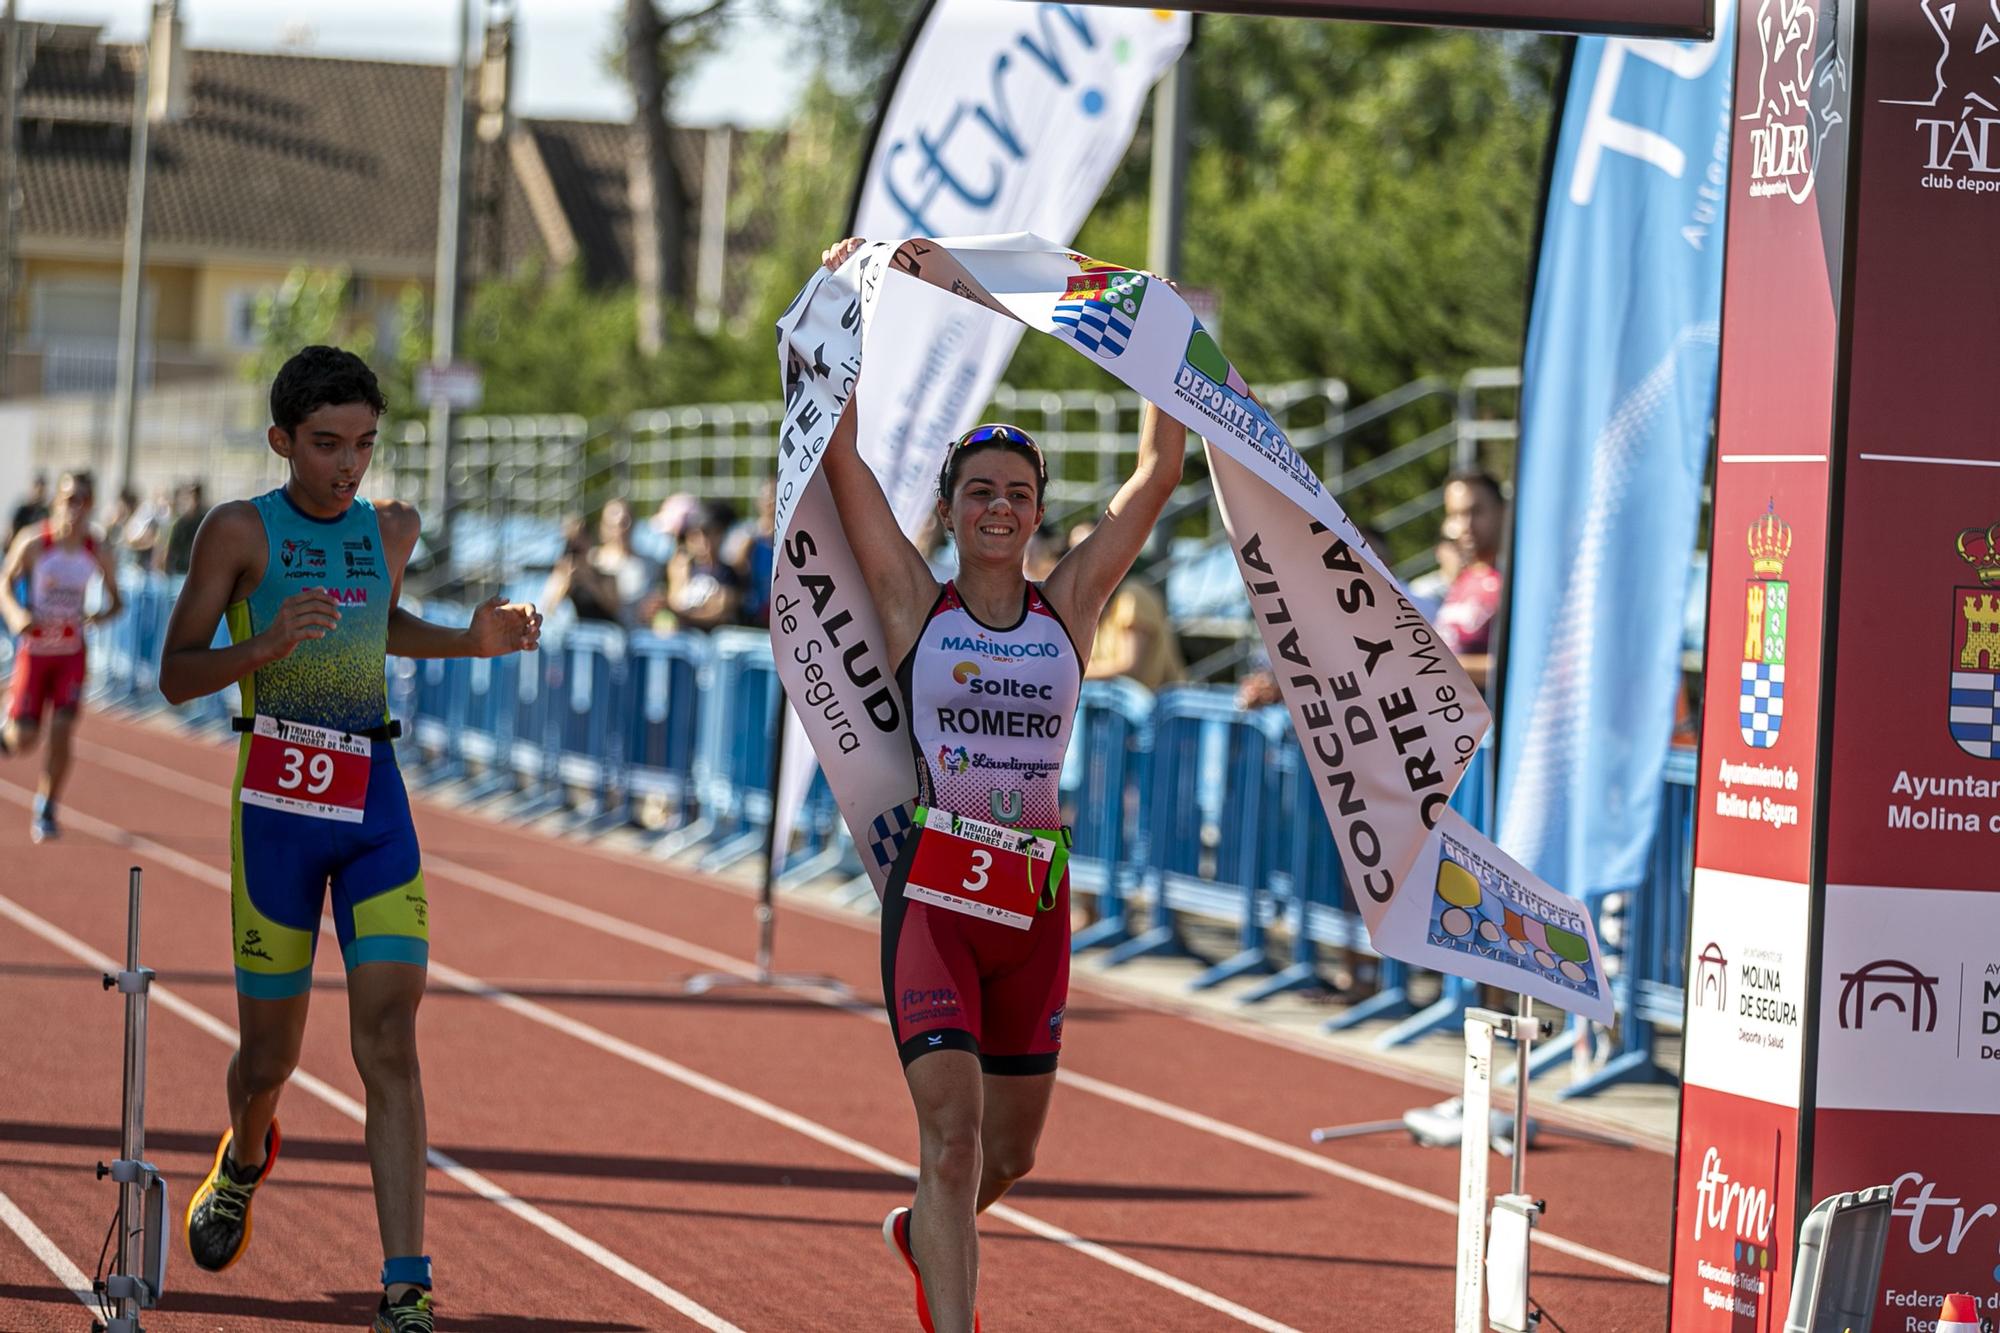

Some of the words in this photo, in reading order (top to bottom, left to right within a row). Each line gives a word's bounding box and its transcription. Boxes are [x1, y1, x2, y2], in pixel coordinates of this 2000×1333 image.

[1750, 113, 1808, 179] TÁDER
[1921, 173, 1953, 189] club
[1174, 388, 1234, 433] AYUNTAMIENTO
[1235, 428, 1247, 443] DE
[1248, 439, 1277, 465] MOLINA
[1278, 462, 1290, 474] DE
[1290, 471, 1319, 499] SEGURA
[1178, 367, 1254, 433] DEPORTE
[1255, 421, 1268, 441] Y
[1270, 435, 1319, 488] SALUD
[799, 436, 825, 474] de
[1309, 520, 1376, 615] SA
[785, 529, 900, 733] SALUD
[775, 593, 801, 635] de
[794, 639, 861, 755] Segura
[1353, 636, 1395, 678] Y
[969, 678, 1053, 701] soltec
[1328, 670, 1379, 746] DE
[1428, 684, 1465, 723] de
[290, 725, 327, 740] TRIATLÓN
[937, 707, 1063, 740] ROMERO
[1240, 532, 1395, 904] CONCEJALÍA
[289, 734, 325, 748] MENORES
[327, 740, 337, 749] DE
[339, 743, 366, 755] MOLINA
[277, 747, 335, 795] 39
[964, 820, 1004, 839] TRIATLÓN
[1762, 796, 1798, 829] Segura
[1887, 804, 1981, 832] Molina
[963, 830, 1001, 847] MENORES
[1002, 840, 1013, 850] DE
[1014, 844, 1045, 860] MOINA
[1444, 842, 1492, 886] SALUD
[961, 849, 994, 892] 3
[1510, 891, 1583, 933] DEPORTE
[1741, 963, 1781, 993] MOLINA
[1740, 993, 1754, 1018] DE
[1755, 996, 1798, 1028] SEGURA
[1694, 1146, 1775, 1242] ftrm
[1885, 1289, 1982, 1309] Federan
